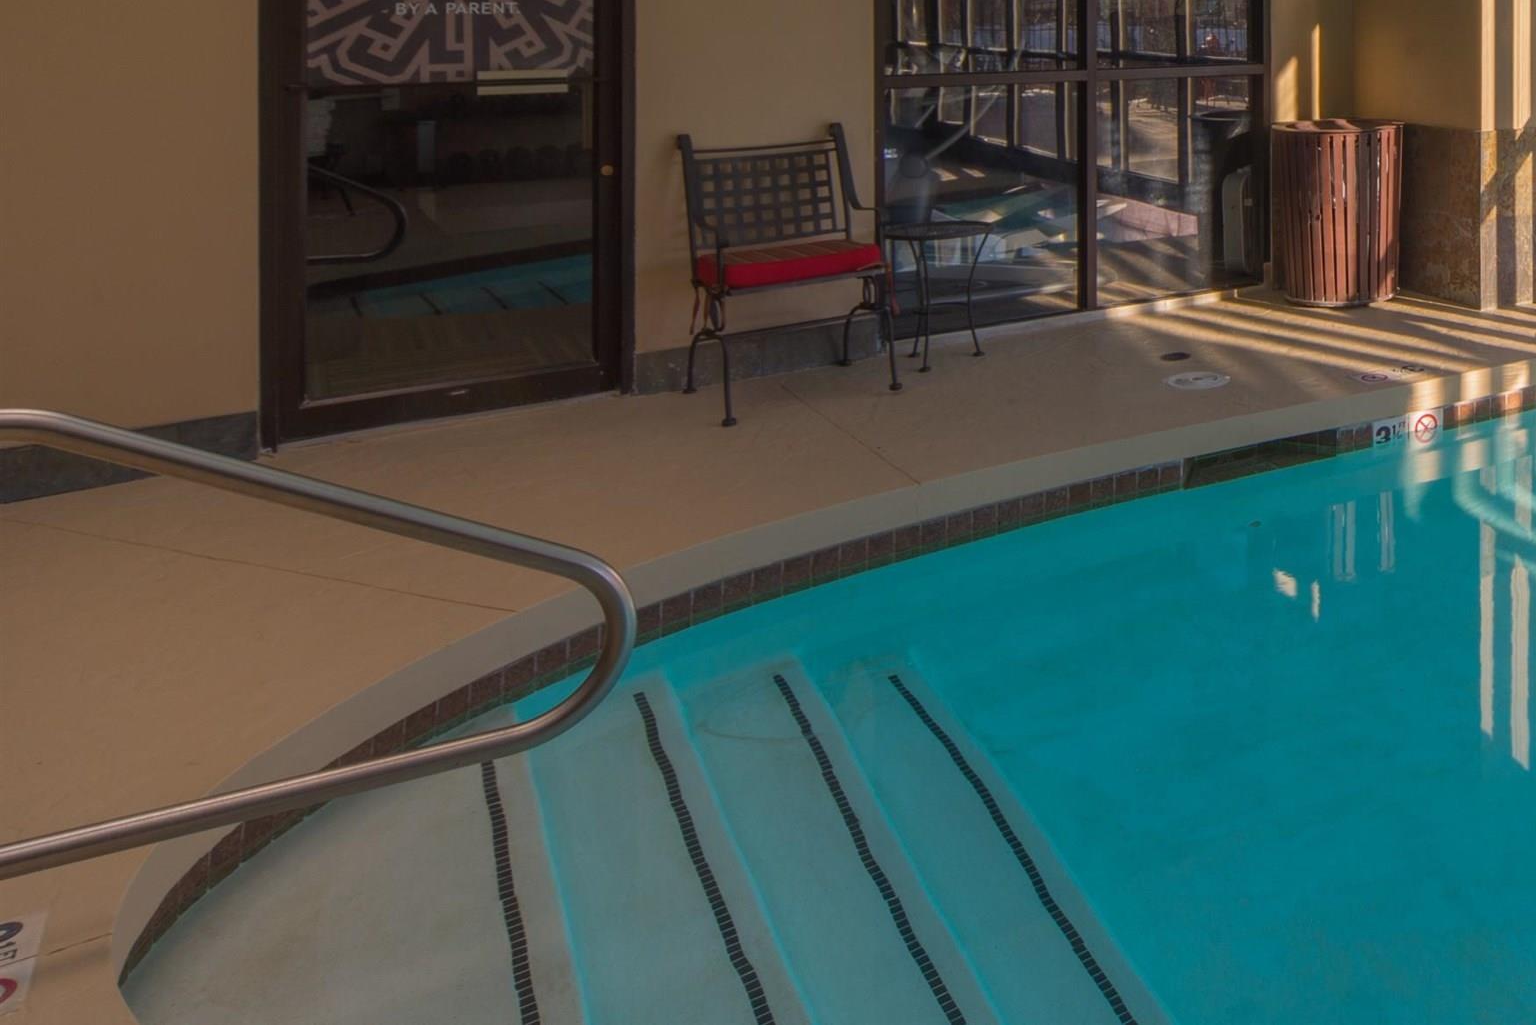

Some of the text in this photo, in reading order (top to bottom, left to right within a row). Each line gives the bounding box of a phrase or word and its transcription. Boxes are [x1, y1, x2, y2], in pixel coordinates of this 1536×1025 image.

[395, 2, 520, 15] BY A PARENT.
